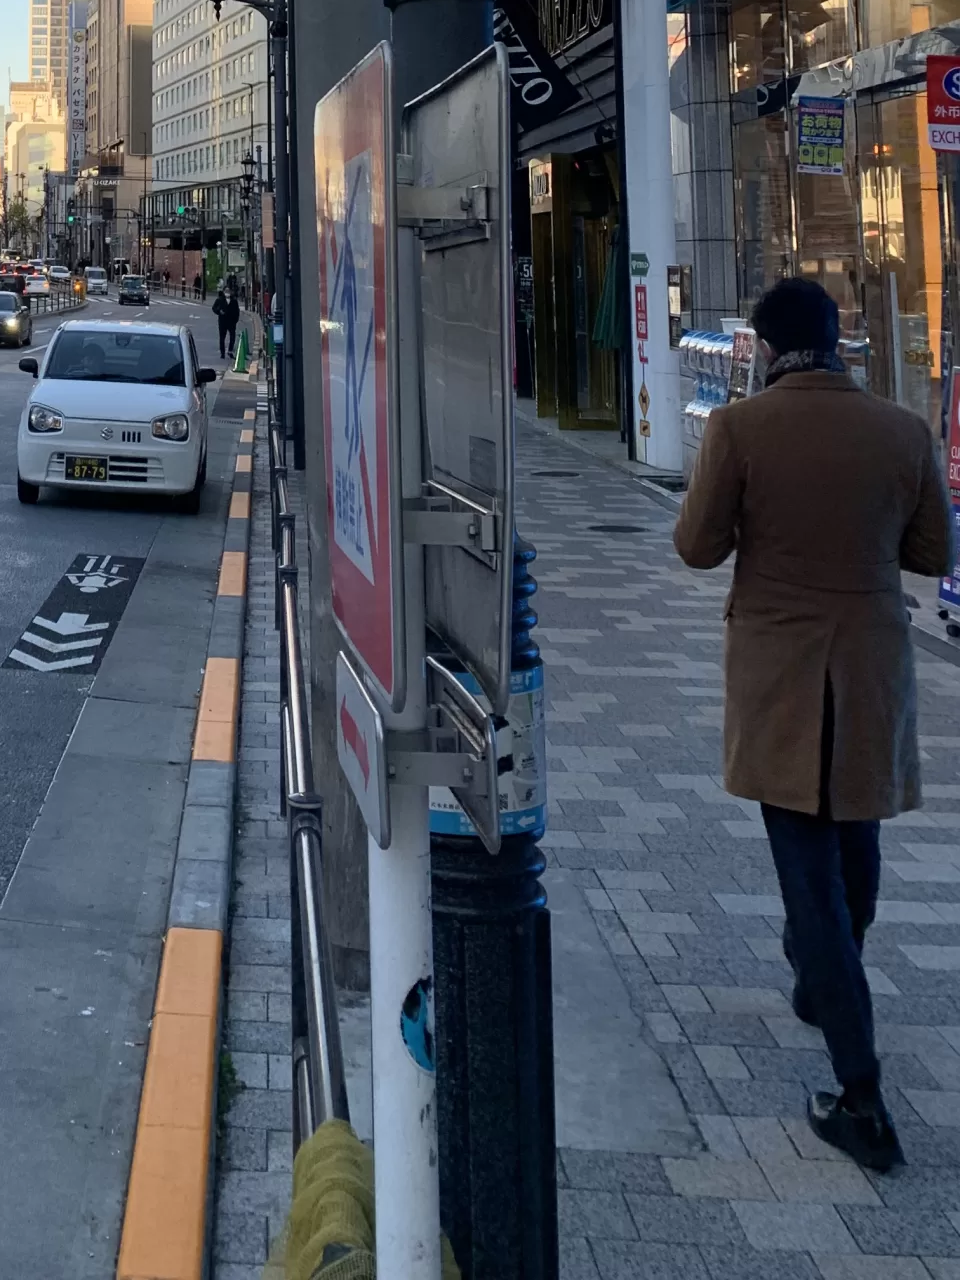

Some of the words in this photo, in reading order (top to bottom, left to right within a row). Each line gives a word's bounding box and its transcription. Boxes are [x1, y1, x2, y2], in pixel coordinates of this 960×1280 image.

[73, 45, 81, 84] カラオケ
[73, 88, 81, 117] パセラ
[74, 466, 106, 479] 87-79
